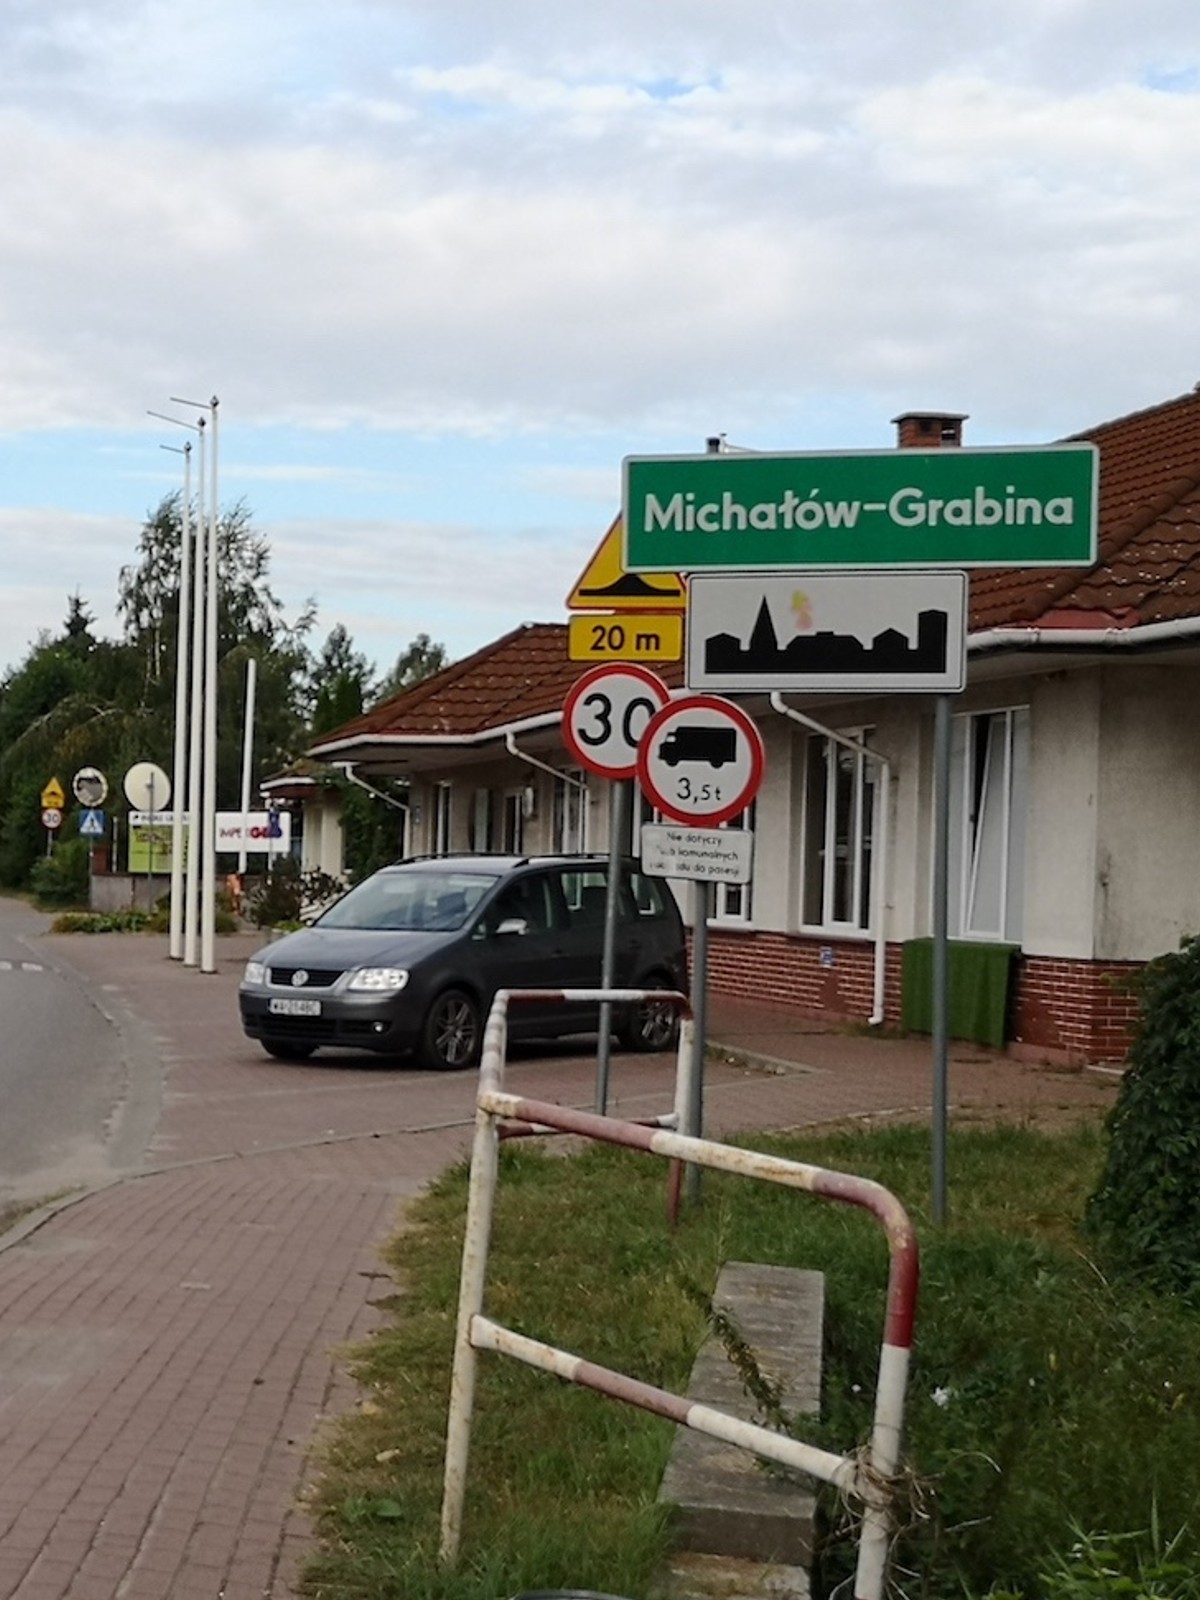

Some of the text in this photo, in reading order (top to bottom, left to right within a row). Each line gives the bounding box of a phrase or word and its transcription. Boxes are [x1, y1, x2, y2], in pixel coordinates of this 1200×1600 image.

[644, 486, 1074, 532] Michałów-Grabina
[590, 625, 661, 651] 20 m
[578, 692, 657, 749] 30
[685, 832, 722, 846] dotyczy
[677, 848, 739, 862] komunalnych
